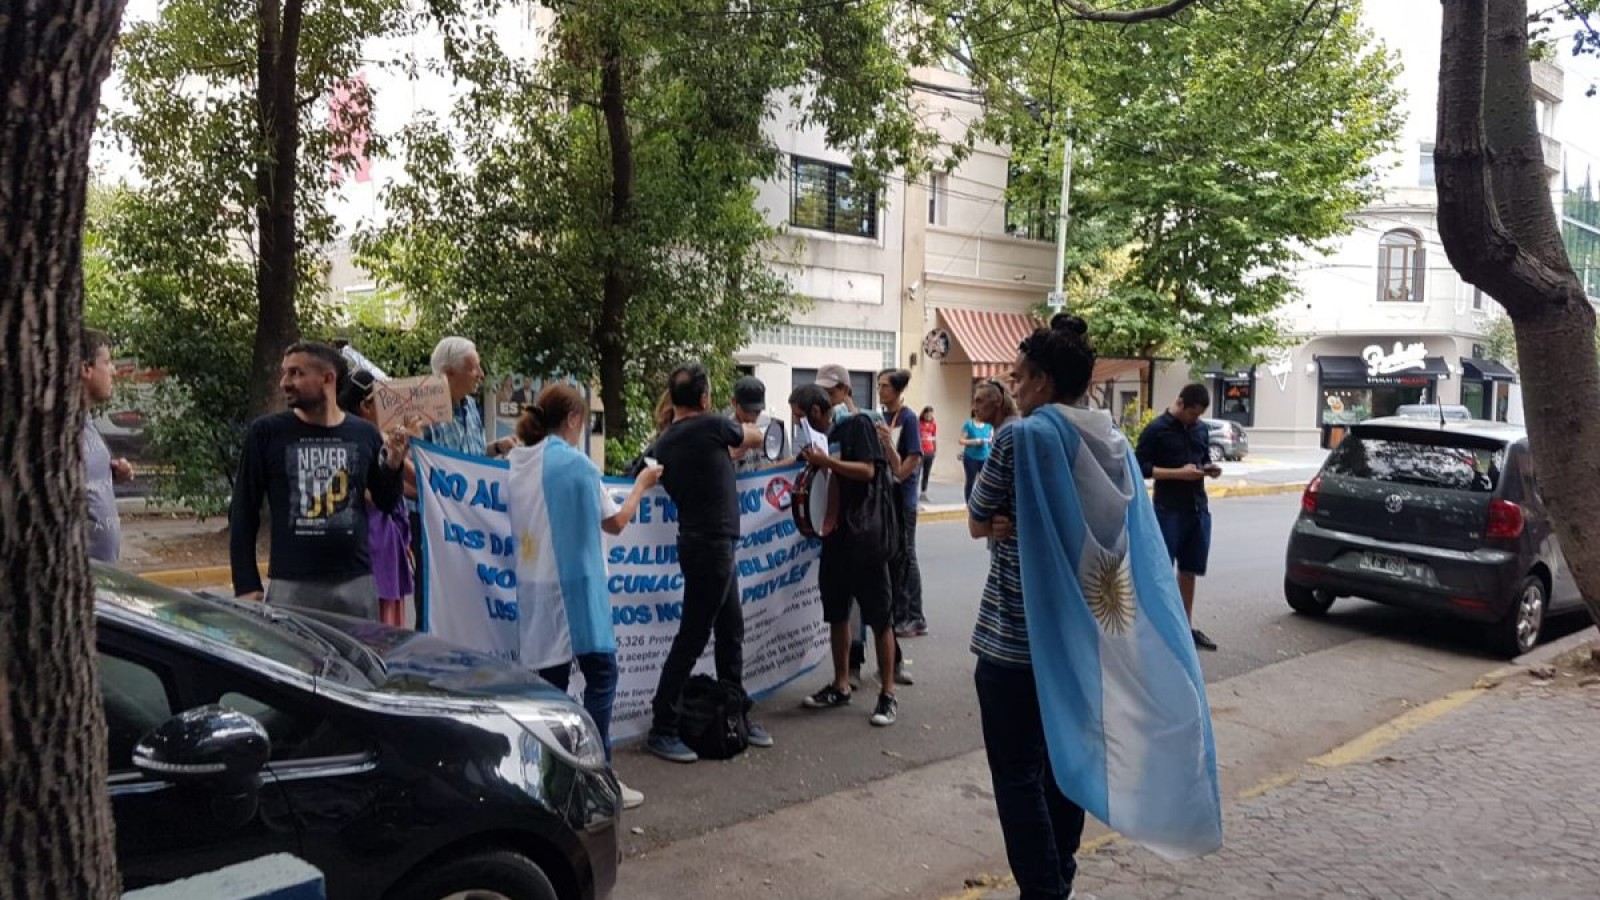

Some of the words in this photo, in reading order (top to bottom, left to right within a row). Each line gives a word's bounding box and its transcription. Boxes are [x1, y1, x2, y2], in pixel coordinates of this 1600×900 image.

[298, 447, 347, 469] NEVER
[430, 466, 467, 501] NO
[470, 479, 508, 512] AL
[477, 563, 517, 588] NO
[485, 595, 518, 621] LOS
